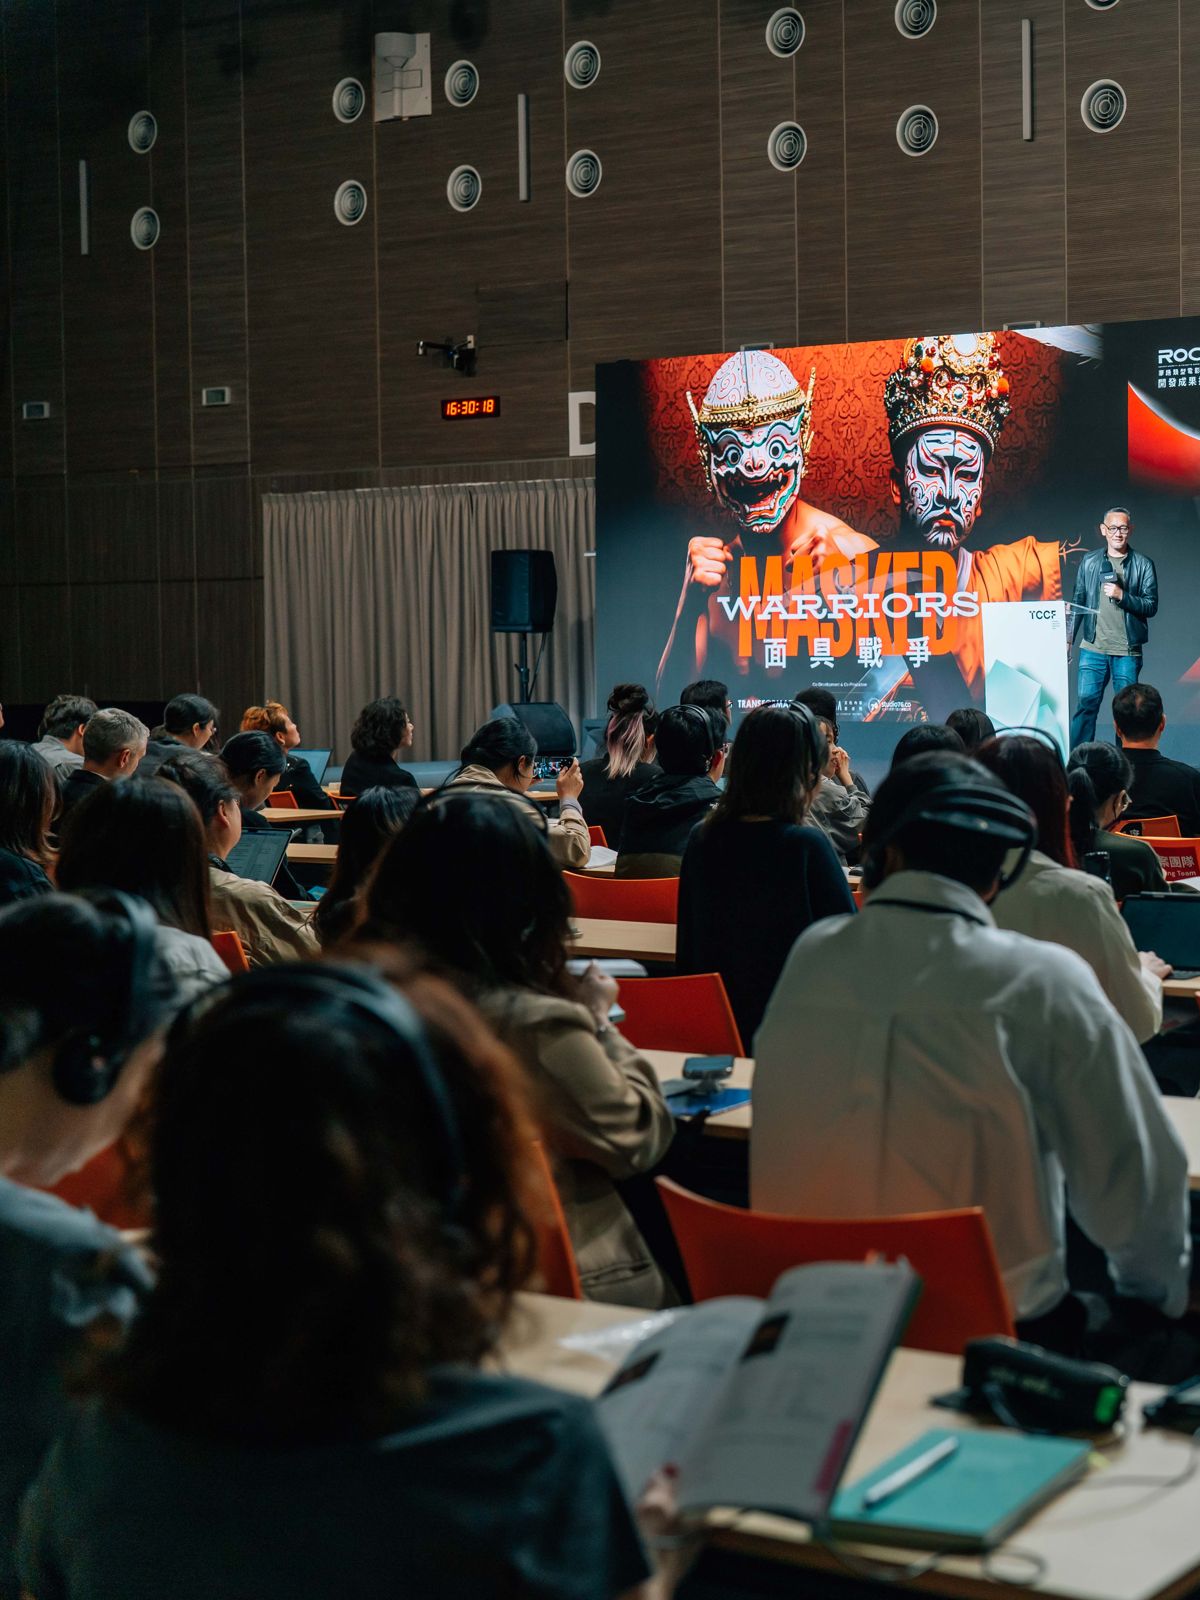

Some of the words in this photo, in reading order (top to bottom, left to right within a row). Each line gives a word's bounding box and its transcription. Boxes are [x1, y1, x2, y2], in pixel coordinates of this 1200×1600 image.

[446, 399, 495, 416] 16:30:18
[717, 591, 980, 621] WARRIORS
[738, 551, 959, 657] MASKED
[1029, 610, 1057, 620] TCCF
[763, 635, 932, 669] 面具戰爭
